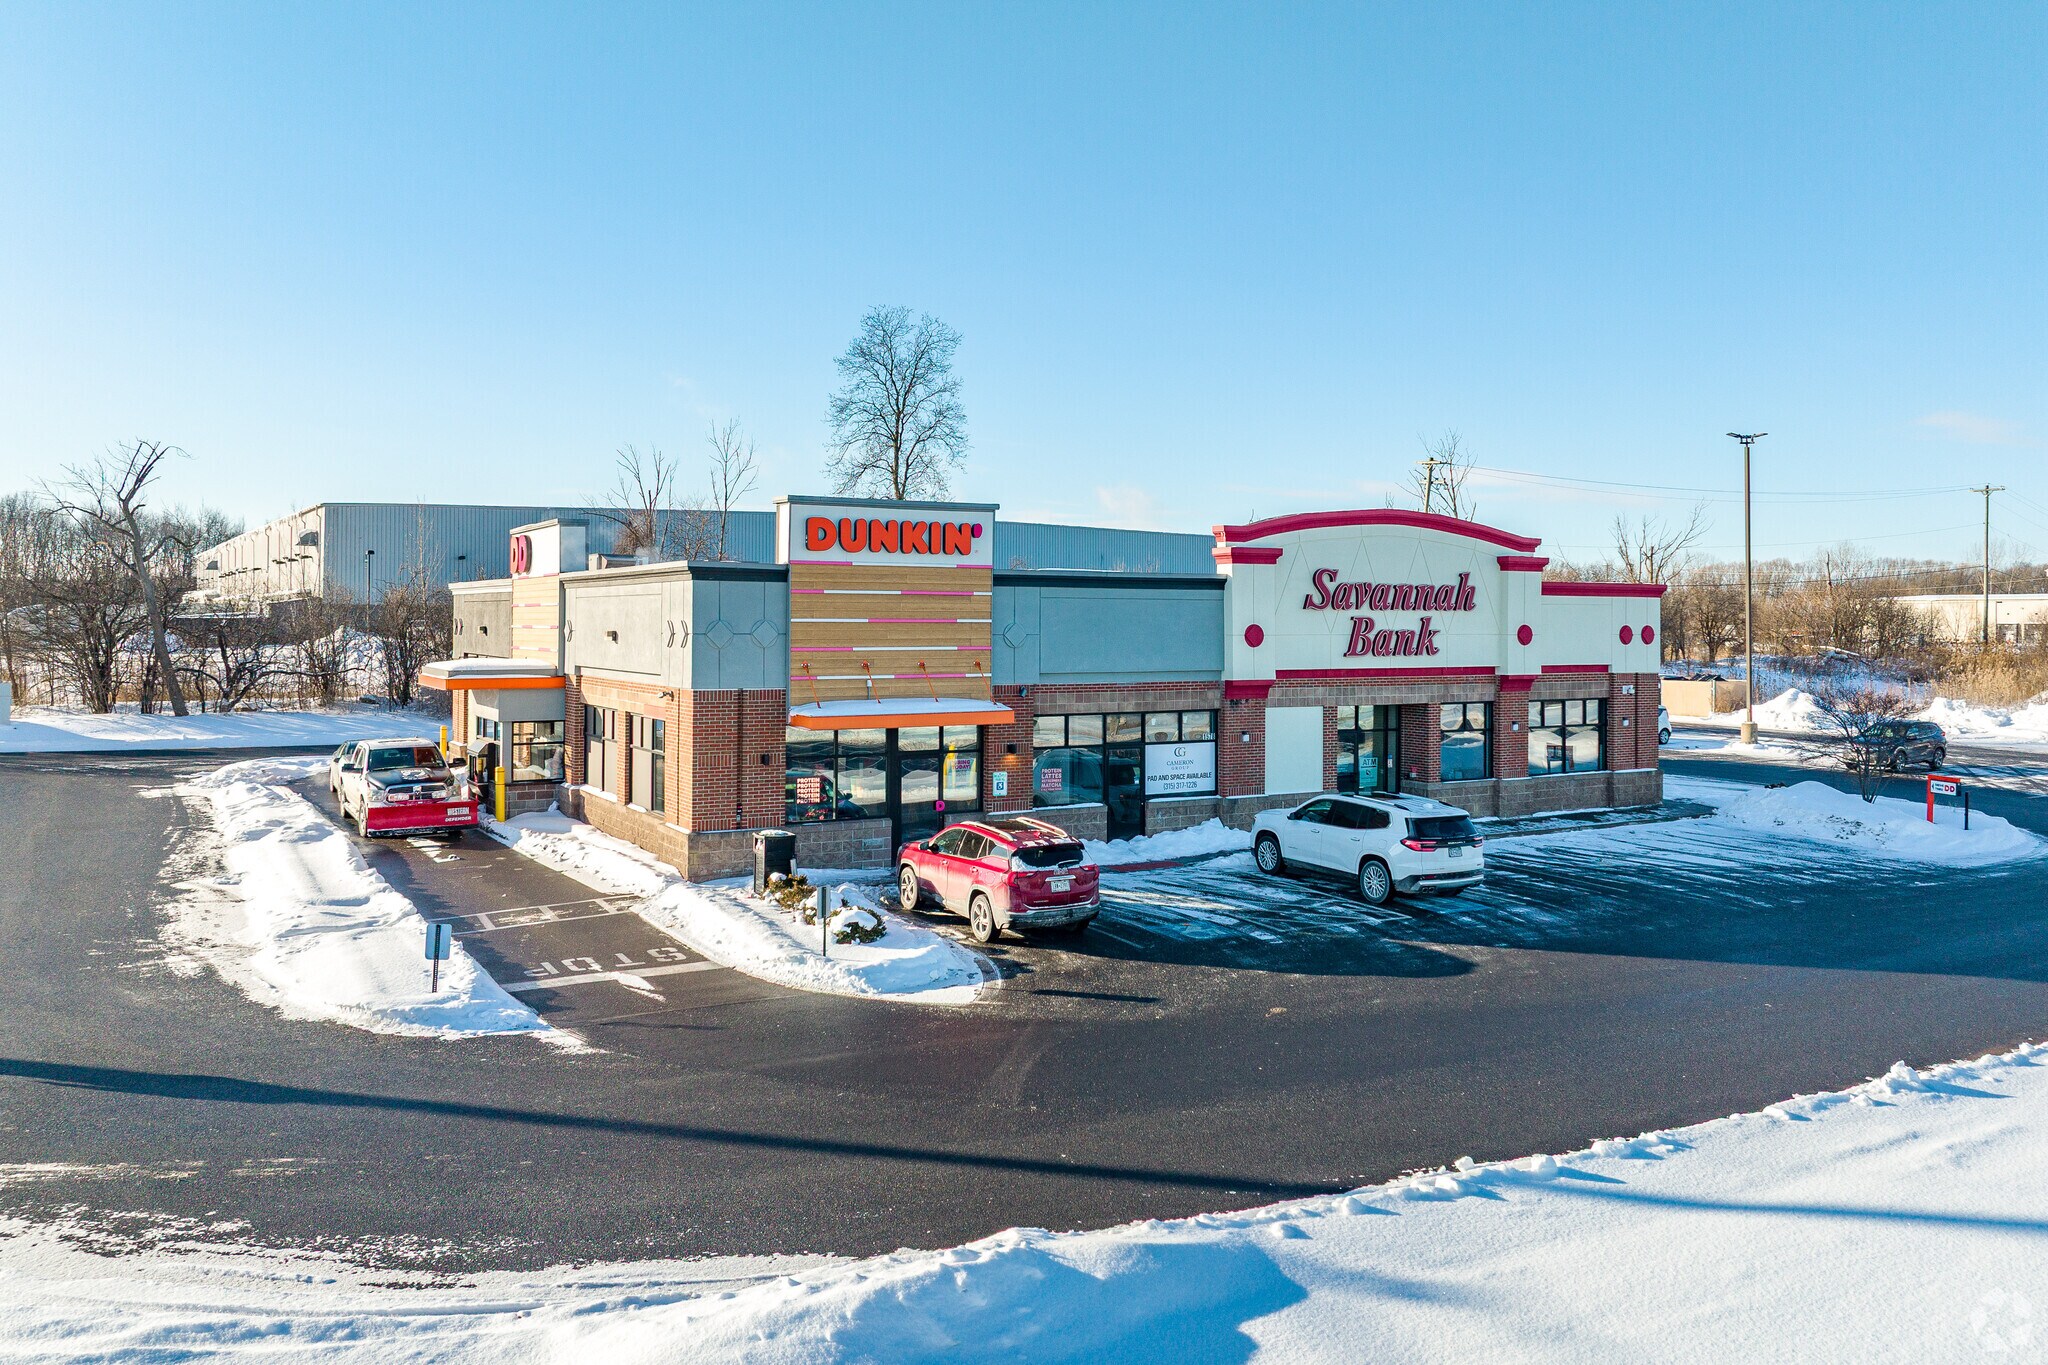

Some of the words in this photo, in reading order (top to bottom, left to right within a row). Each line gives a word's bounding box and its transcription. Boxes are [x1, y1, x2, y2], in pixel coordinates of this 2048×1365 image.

[806, 517, 982, 555] DUNKIN'
[1303, 568, 1476, 611] Savannah
[1343, 616, 1441, 657] Bank
[1163, 782, 1175, 791] (315)
[1944, 784, 1955, 792] DD
[523, 946, 687, 978] STOP
